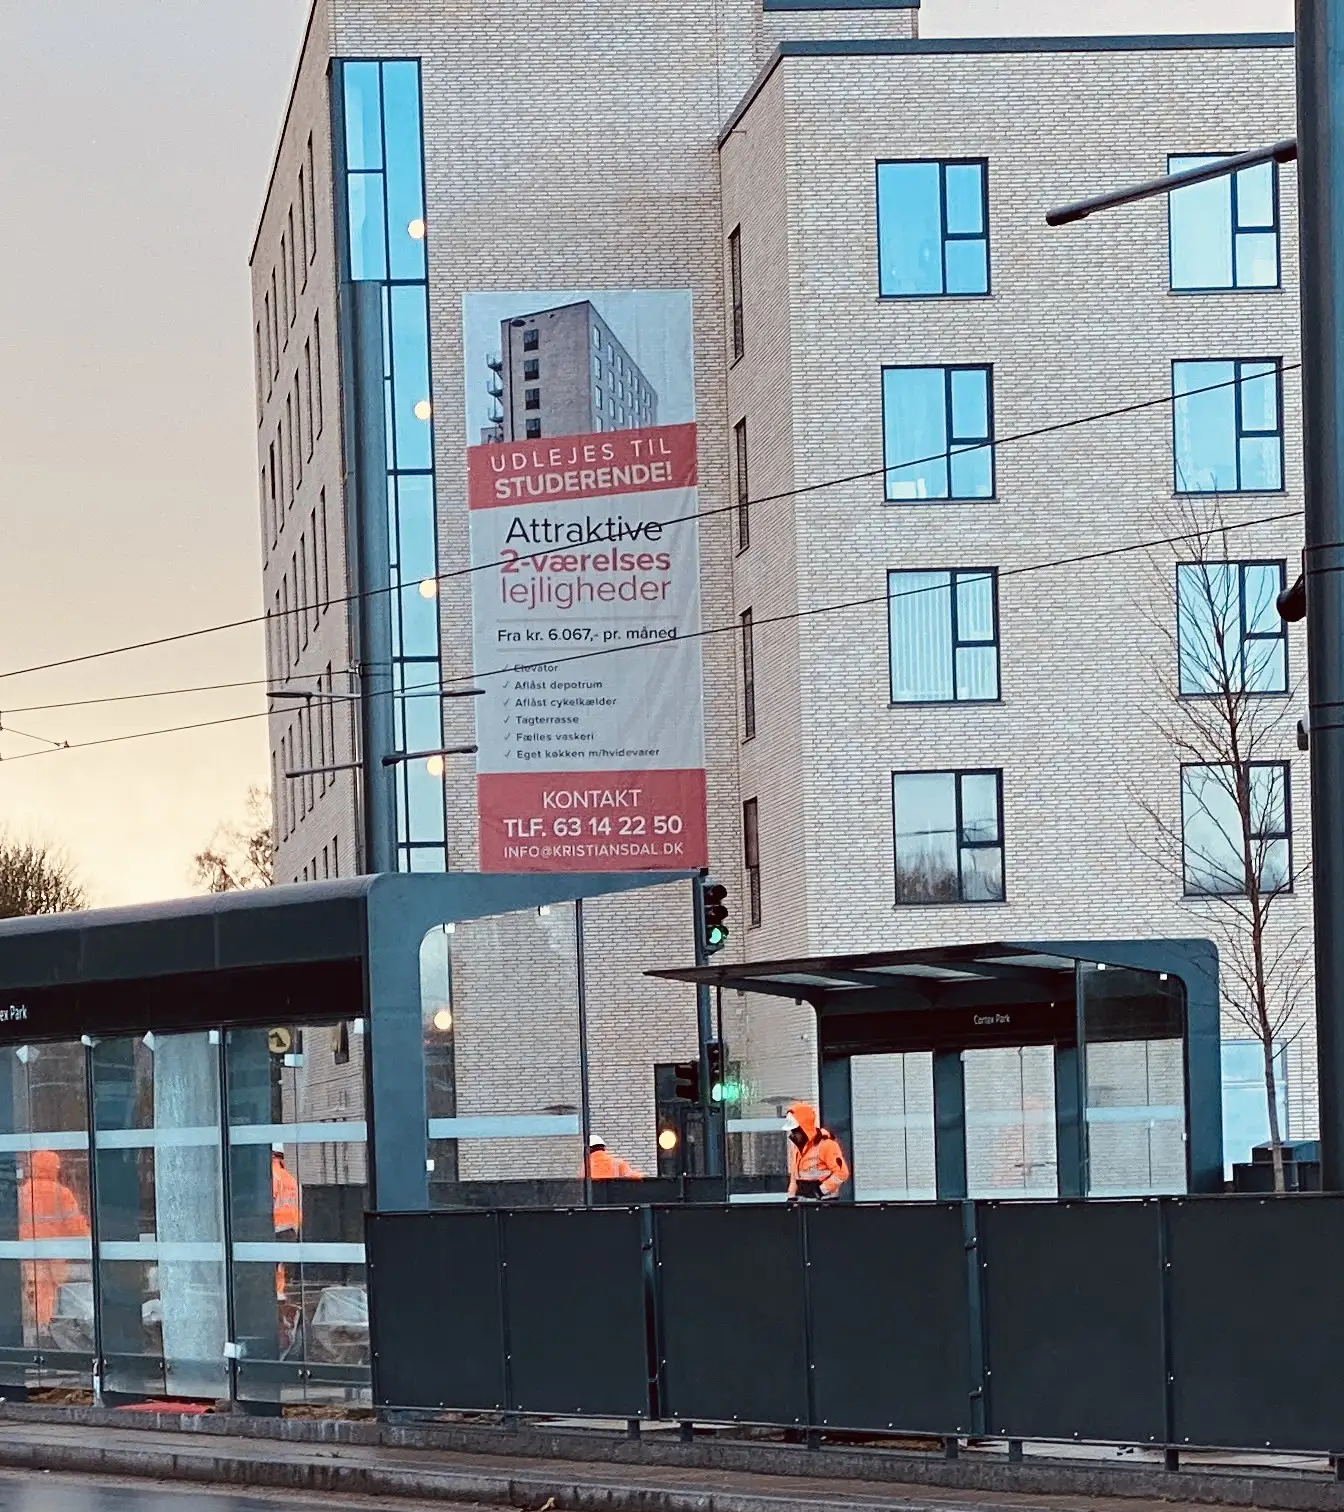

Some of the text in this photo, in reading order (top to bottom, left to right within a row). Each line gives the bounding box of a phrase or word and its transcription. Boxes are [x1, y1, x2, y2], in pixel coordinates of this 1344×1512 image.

[490, 437, 672, 472] UDLEJES TIL
[495, 461, 673, 499] STUDERENDE!
[505, 515, 663, 543] Attraktive
[500, 547, 671, 573] 2-værelses
[501, 575, 672, 609] lejligheder
[498, 626, 677, 643] Fra kr. 6.067,- pr. måned
[514, 664, 558, 673] Elevator
[514, 680, 603, 691] Aflåst depotrum
[515, 697, 617, 708] Aflåst cykelkælder
[516, 715, 579, 726] Tagterrasse
[516, 731, 594, 741] Fælles vaskeri
[517, 750, 541, 760] Eget
[588, 748, 660, 758] m/hvidevarer
[543, 789, 642, 809] KONTAKT
[503, 815, 683, 837] TLF. 63 14 22 50
[504, 841, 683, 859] INFO@KRISTIANSDAL.DK
[9, 1004, 28, 1020] Park
